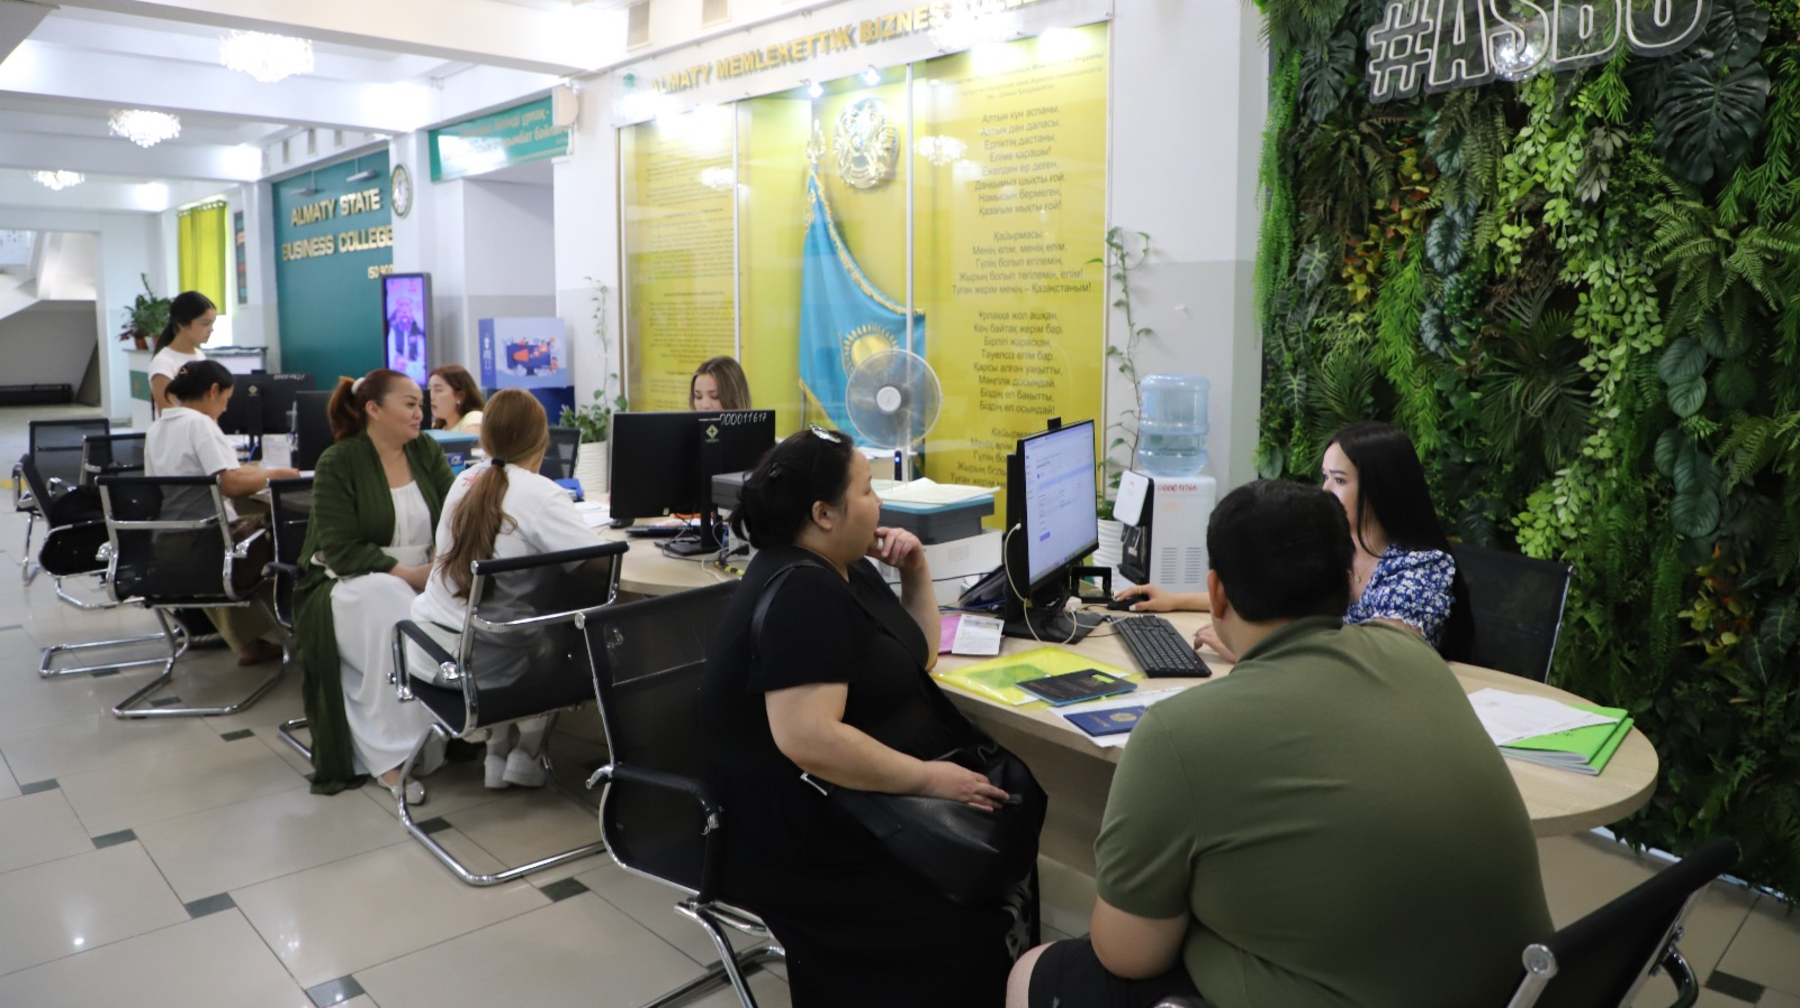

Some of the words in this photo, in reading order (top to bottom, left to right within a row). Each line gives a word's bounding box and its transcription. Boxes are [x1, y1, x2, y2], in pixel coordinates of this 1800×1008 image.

[652, 62, 712, 93] ALMATY
[716, 25, 852, 80] MEMLEKETTIK
[292, 198, 337, 226] ALMATY
[340, 188, 380, 216] STATE
[282, 233, 335, 261] BUSINESS
[339, 224, 393, 253] COLLEGE
